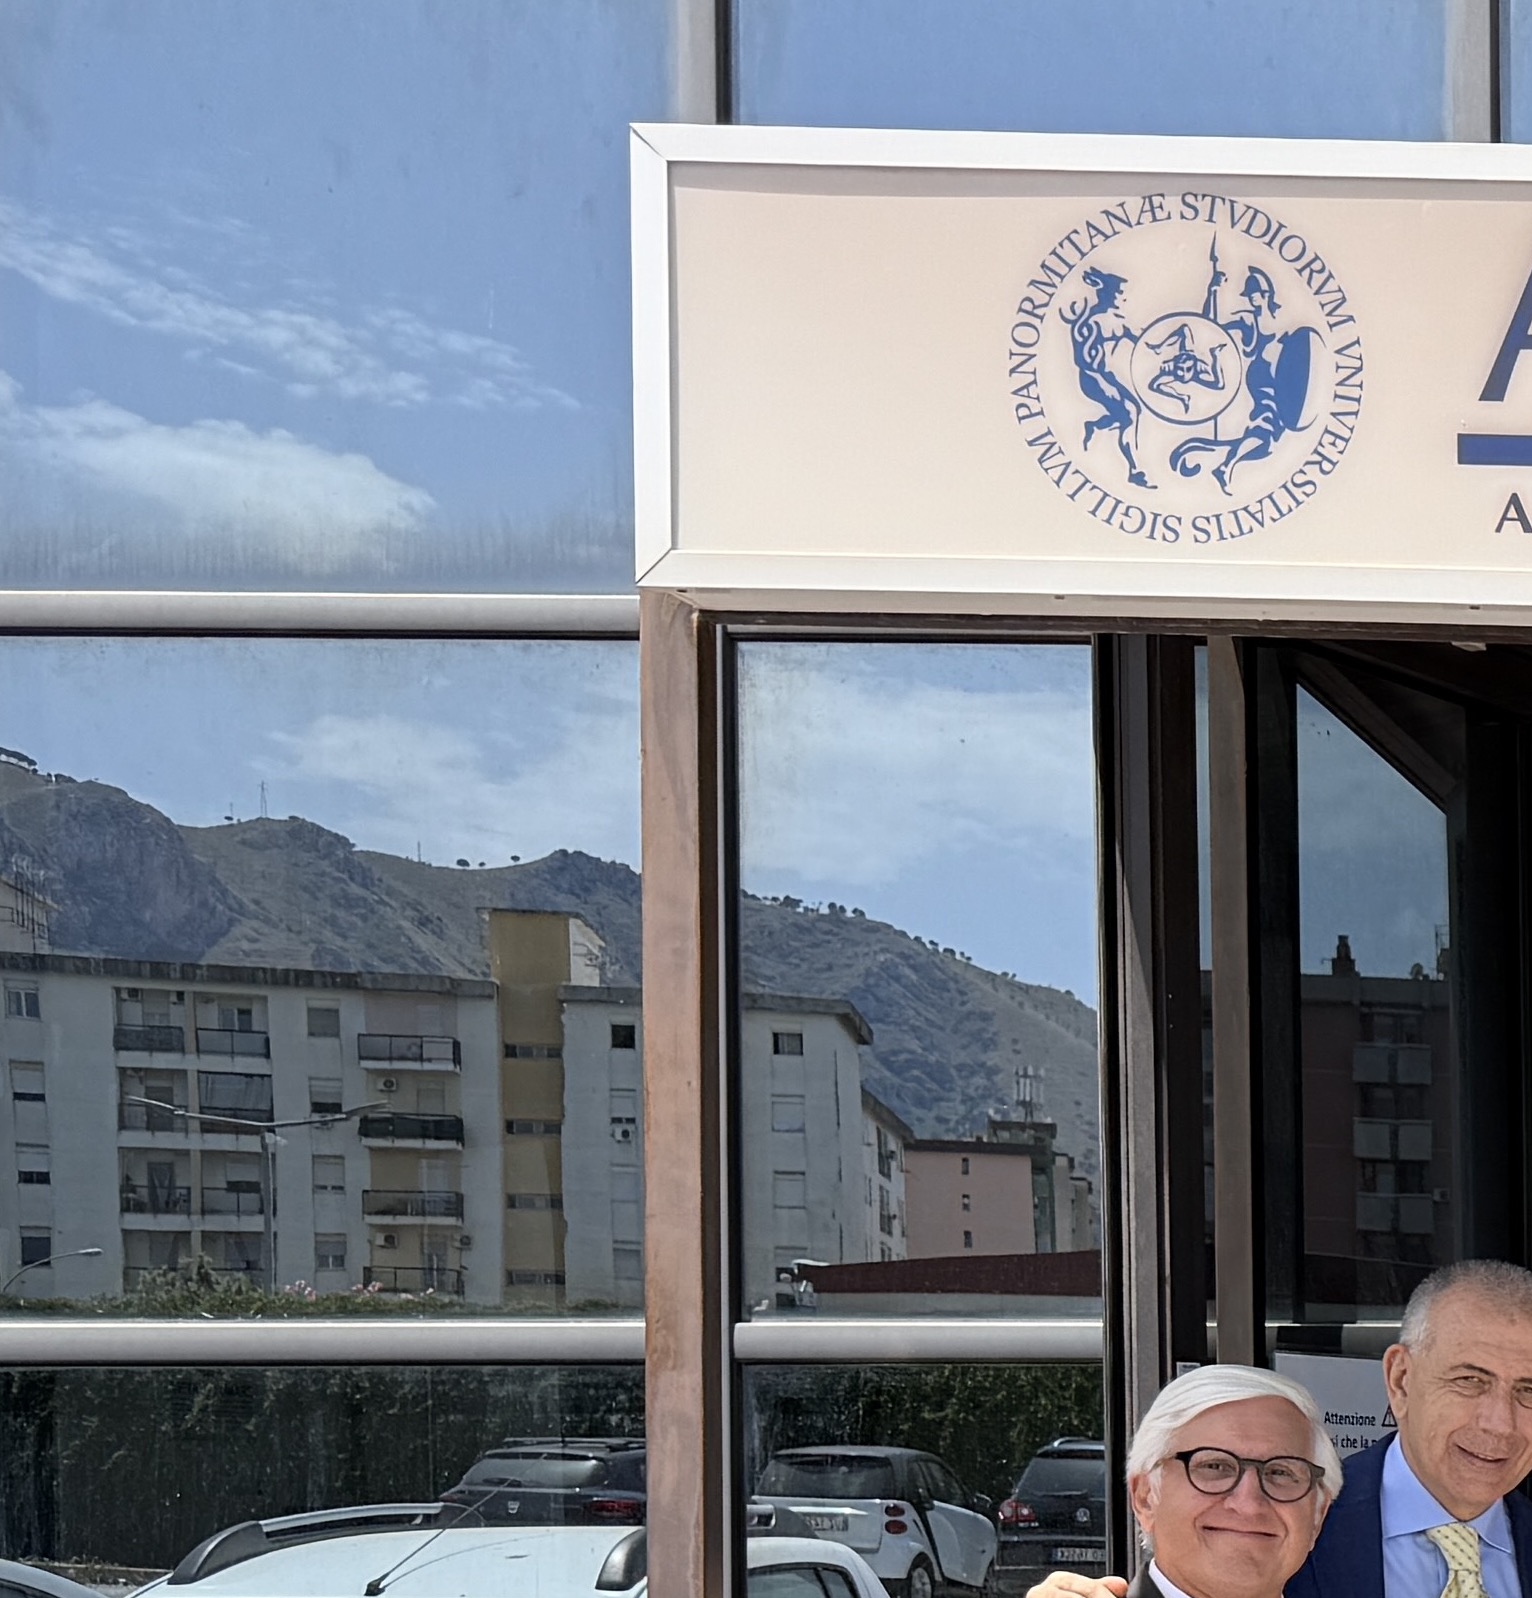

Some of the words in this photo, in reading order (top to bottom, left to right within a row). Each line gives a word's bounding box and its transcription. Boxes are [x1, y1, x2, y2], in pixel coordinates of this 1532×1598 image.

[1008, 192, 1172, 425] PANORMITANÆ
[1179, 191, 1357, 334] STVDIORVM
[1024, 427, 1183, 544] SIGILLVM
[1191, 336, 1364, 544] VNIVERSITATIS
[1324, 1411, 1376, 1426] Attenzione
[1341, 1434, 1358, 1449] che
[1360, 1435, 1369, 1449] la
